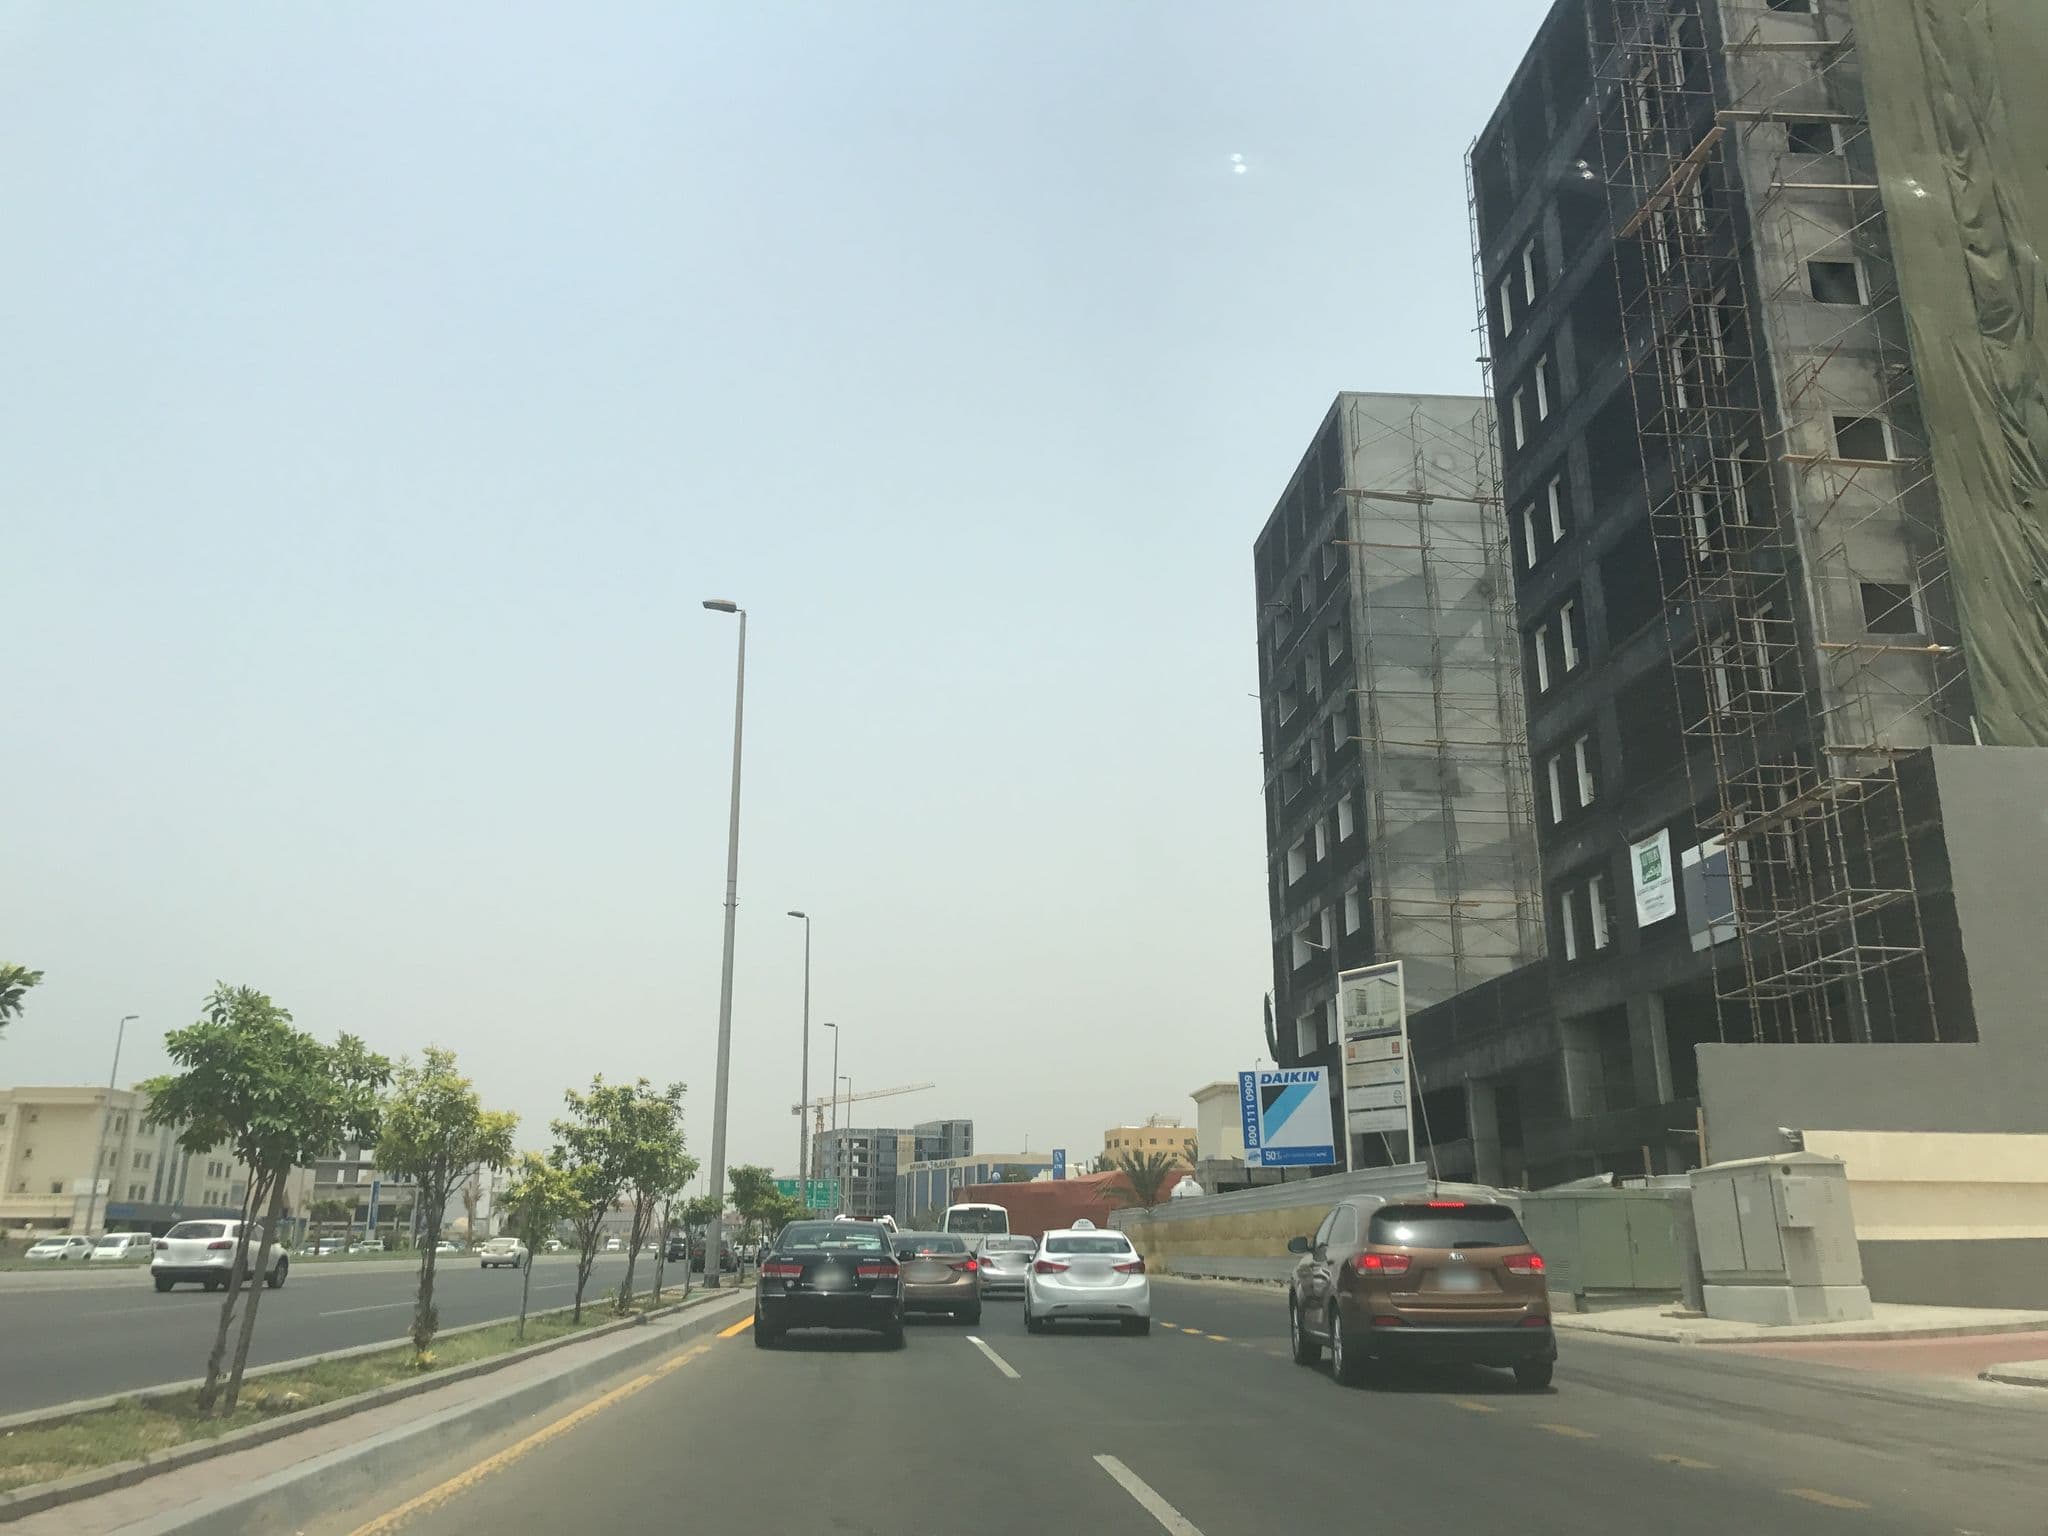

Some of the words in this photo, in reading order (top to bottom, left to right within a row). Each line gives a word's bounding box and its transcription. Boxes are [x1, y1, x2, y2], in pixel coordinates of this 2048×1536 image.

[1261, 1071, 1320, 1084] DAIKIN
[1244, 1075, 1254, 1101] 0909
[1247, 1104, 1256, 1123] 111
[1248, 1125, 1257, 1146] 800
